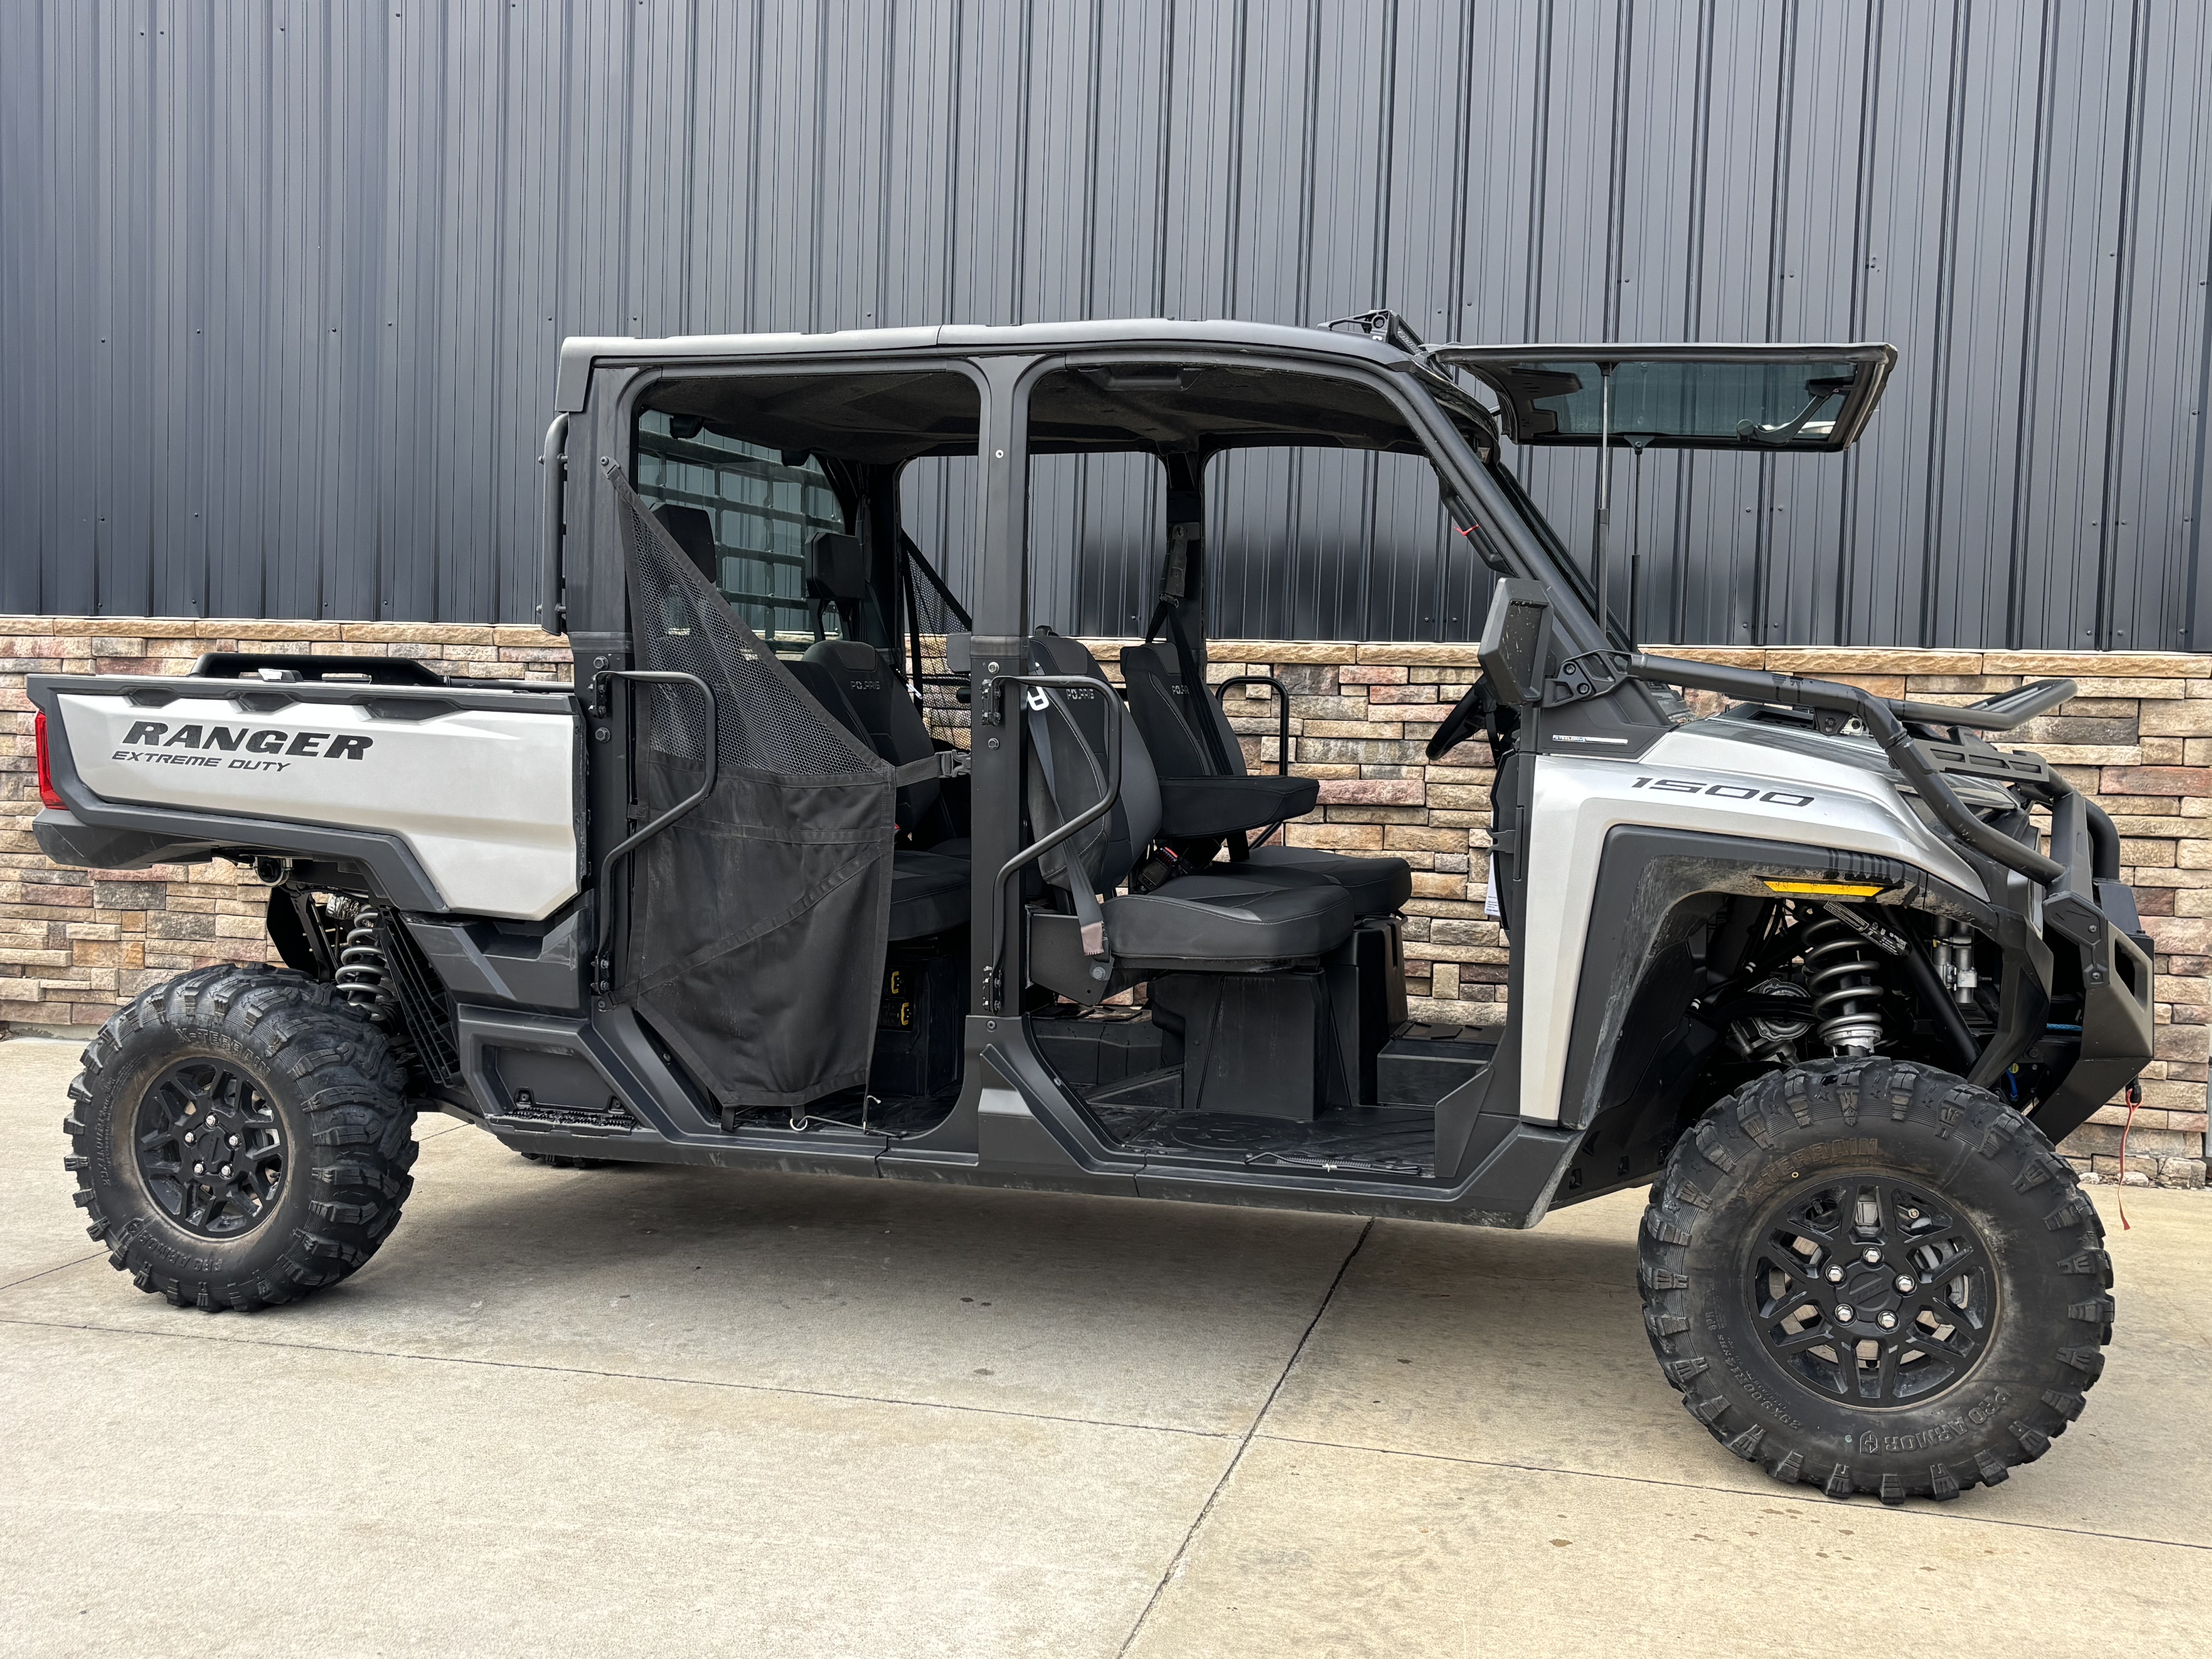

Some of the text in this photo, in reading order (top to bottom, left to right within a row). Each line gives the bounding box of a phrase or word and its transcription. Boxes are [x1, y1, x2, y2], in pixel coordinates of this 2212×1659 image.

[850, 680, 880, 690] POLARIS
[112, 750, 291, 772] EXTREME DUTY
[122, 721, 374, 760] RANGER
[1632, 777, 1815, 807] 1500
[175, 1028, 271, 1079] X-TERRAIN
[1736, 1138, 1879, 1204] X-TERRAIN
[138, 1230, 222, 1272] PRO ARMOR
[1724, 1356, 1804, 1431] 29X9.00R14
[1884, 1386, 2011, 1453] PRO ARMOR
